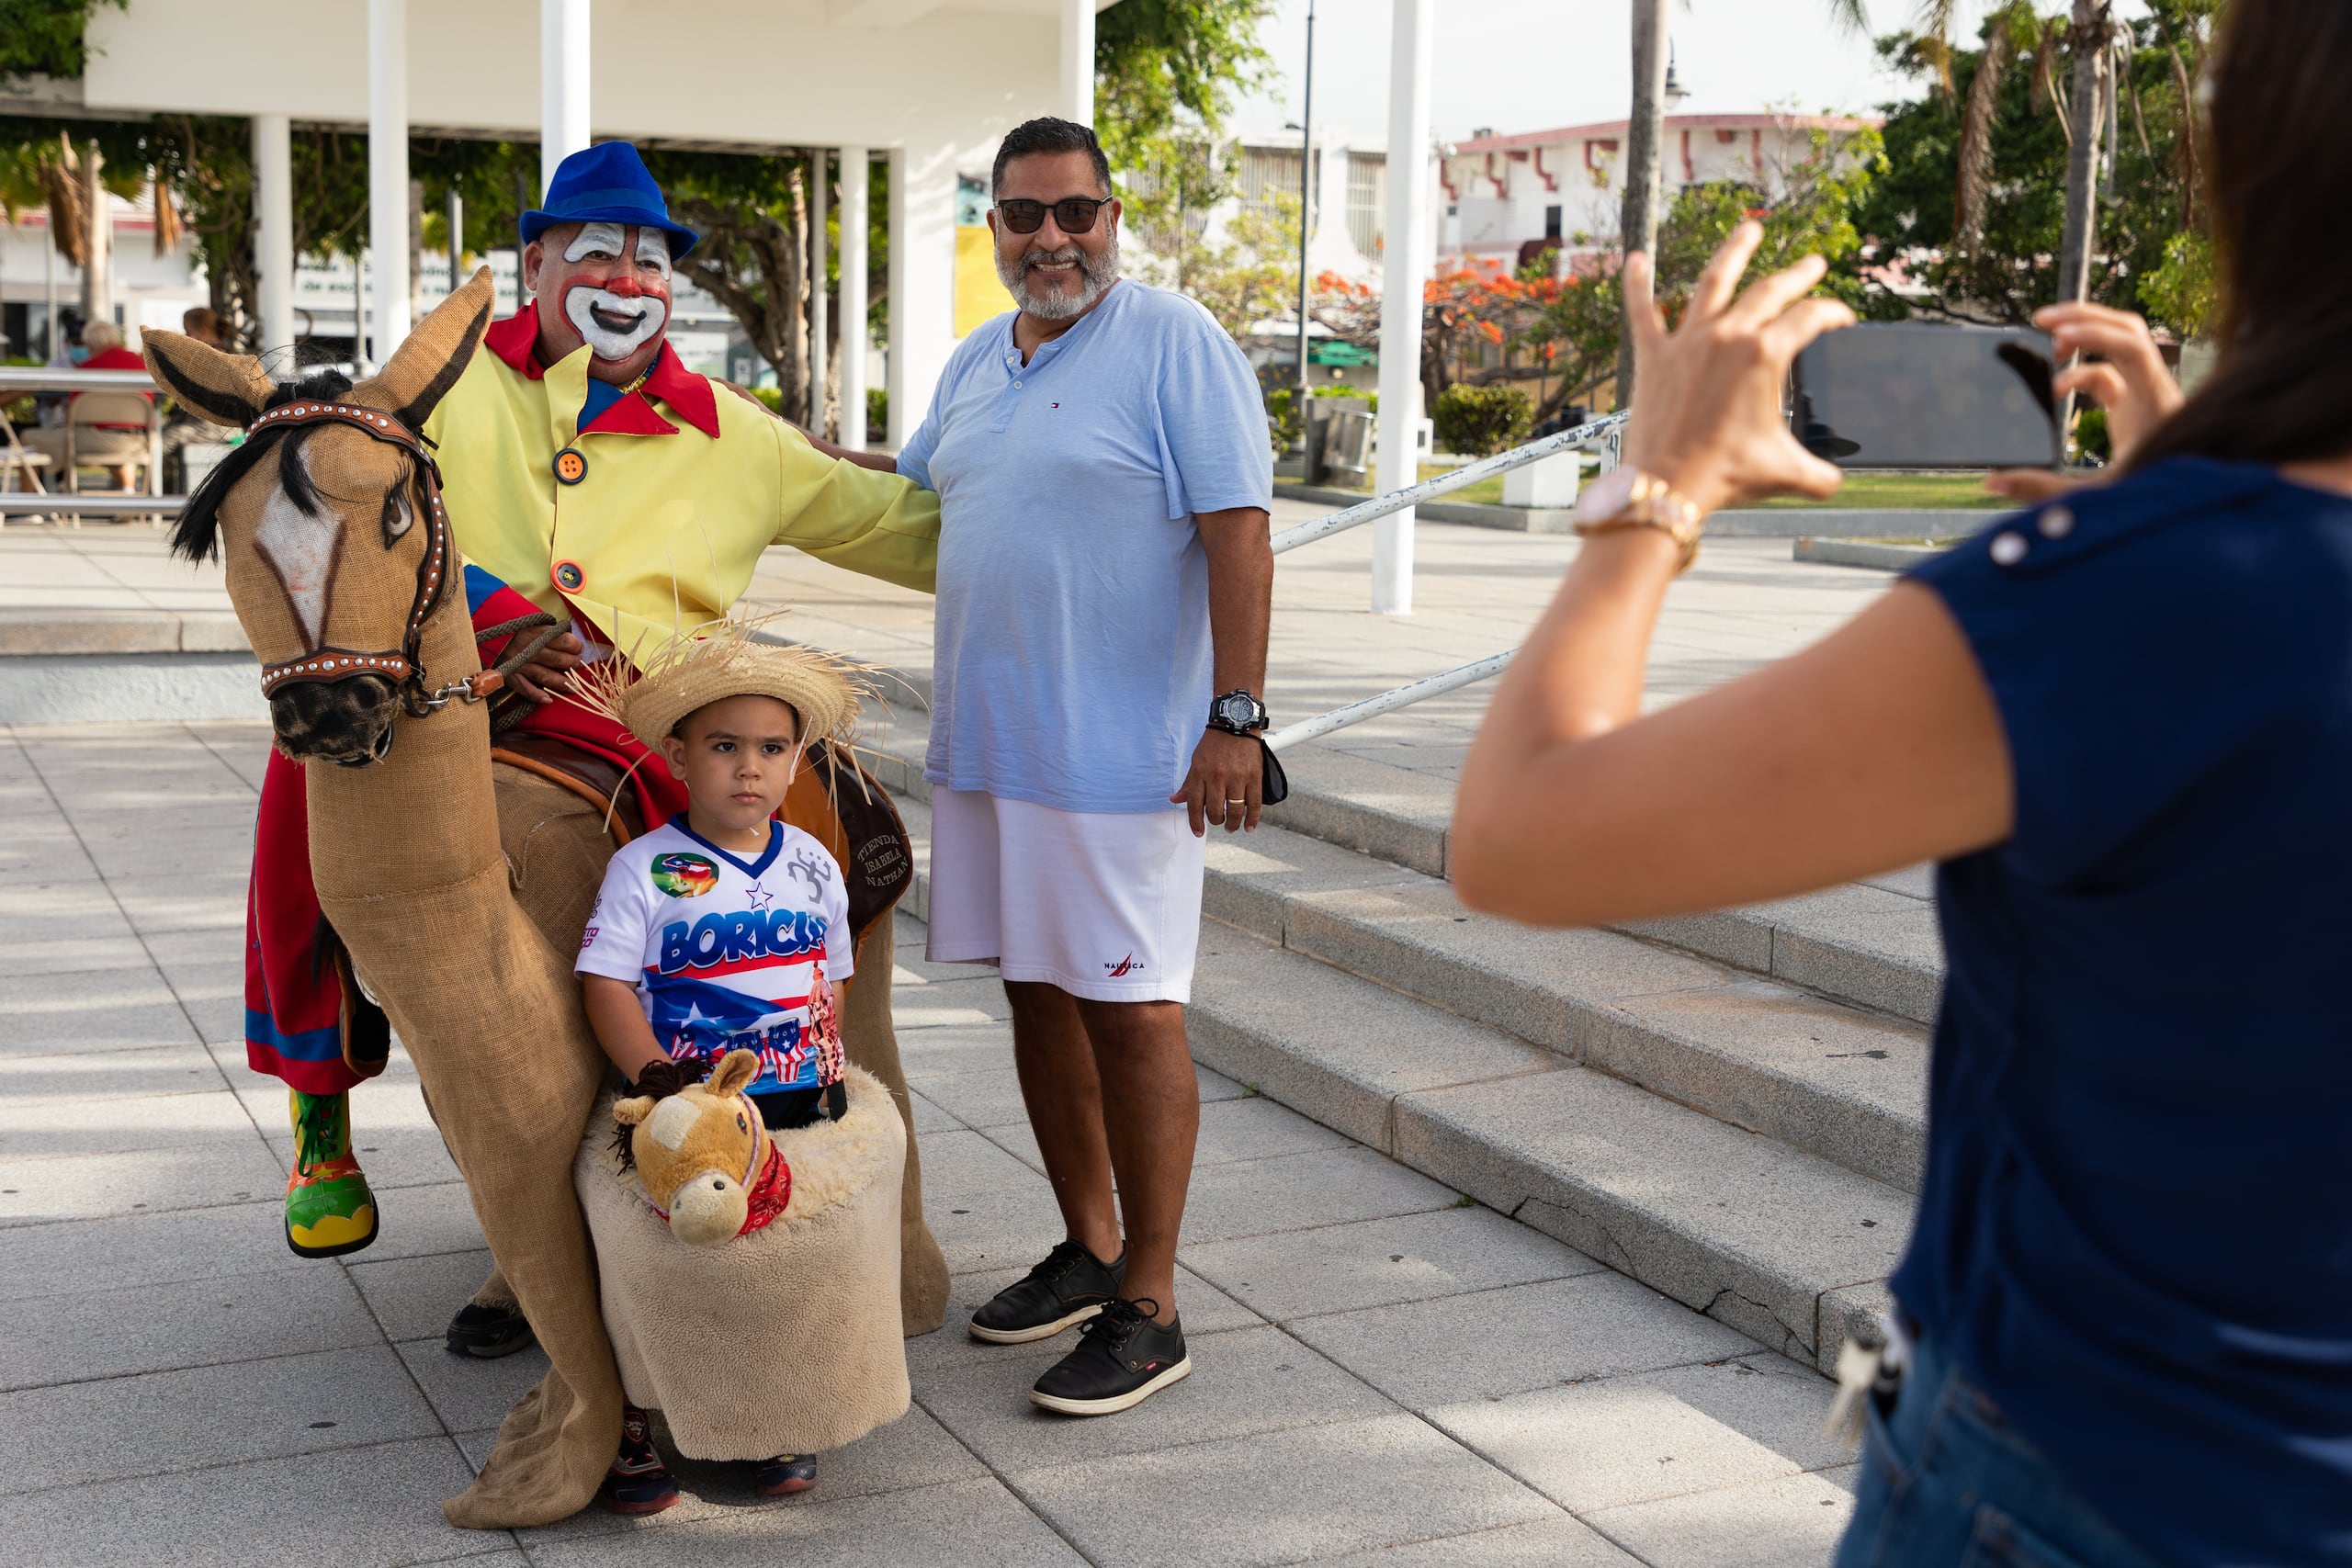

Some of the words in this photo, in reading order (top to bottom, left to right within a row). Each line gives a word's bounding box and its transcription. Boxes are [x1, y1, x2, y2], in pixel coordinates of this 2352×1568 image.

[857, 834, 900, 863] TIENDA
[865, 847, 901, 874] ISABELA
[864, 855, 908, 886] NATHAN
